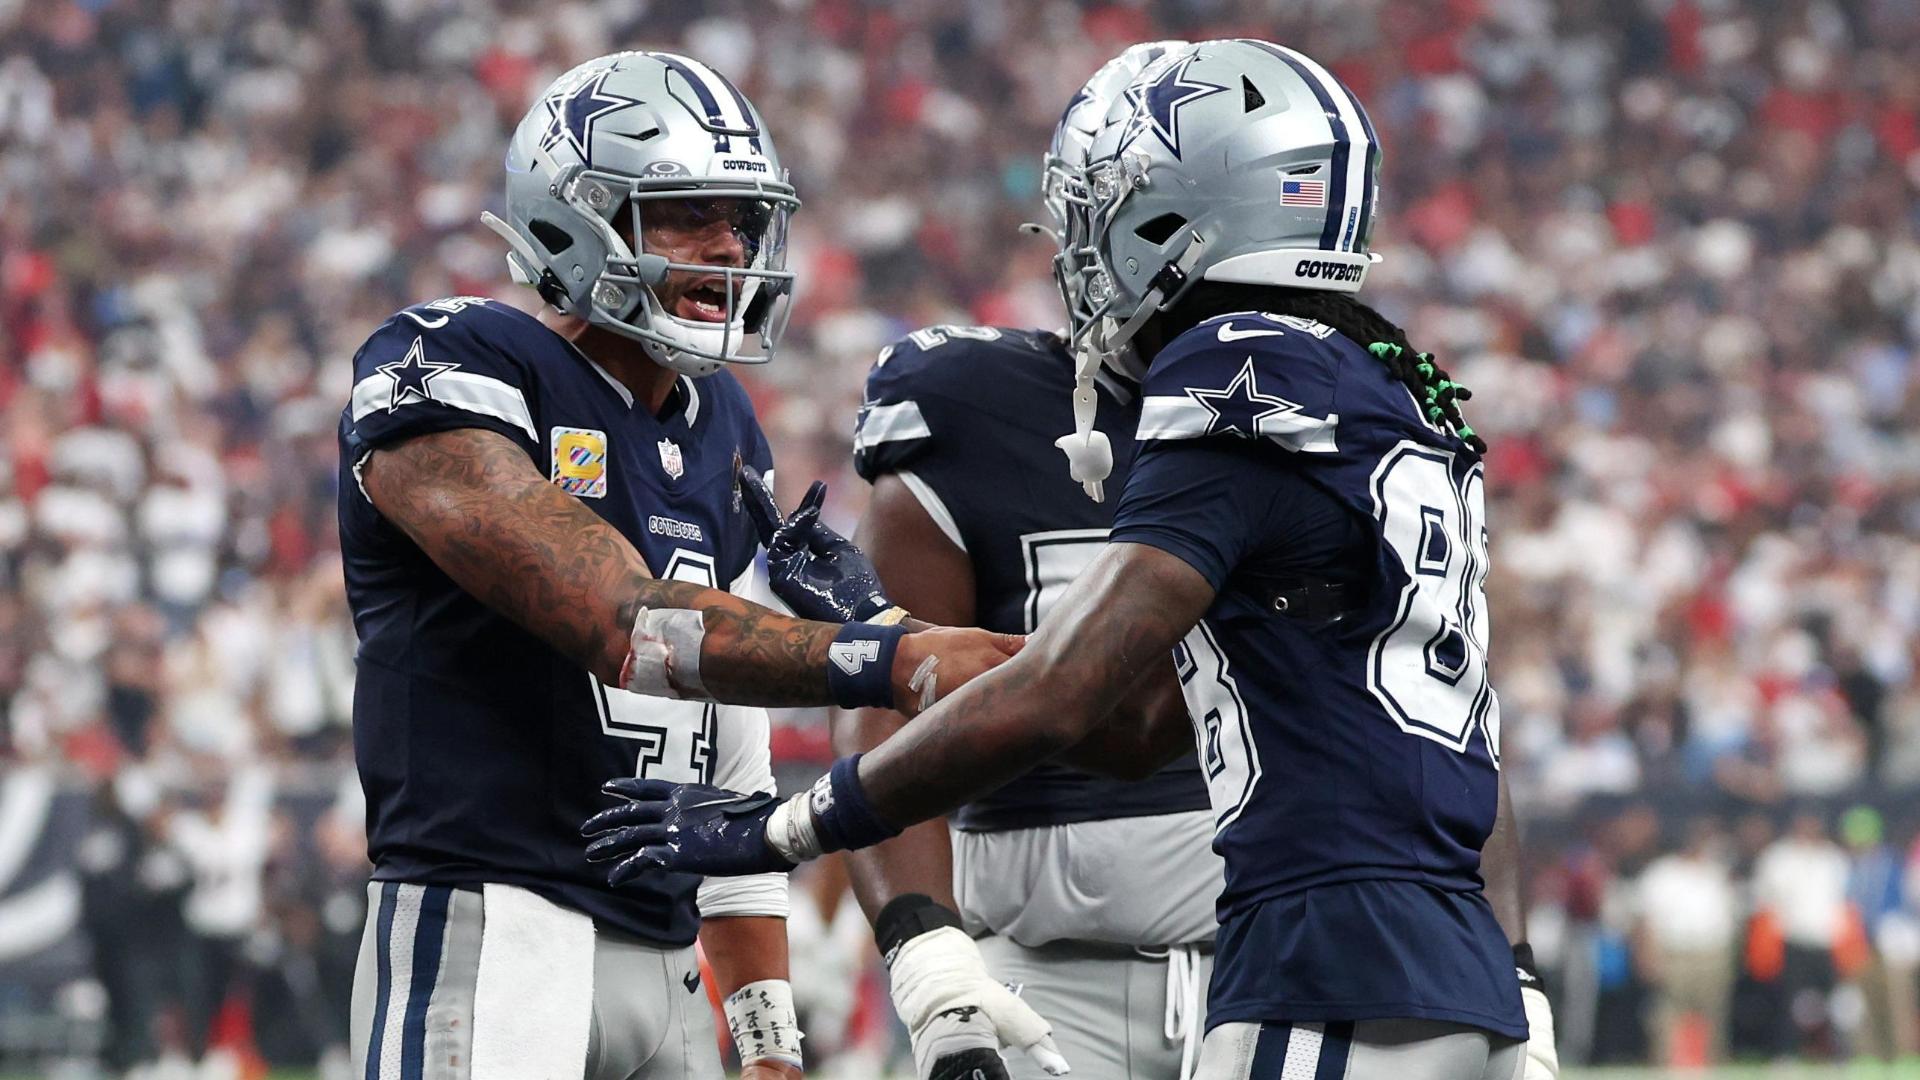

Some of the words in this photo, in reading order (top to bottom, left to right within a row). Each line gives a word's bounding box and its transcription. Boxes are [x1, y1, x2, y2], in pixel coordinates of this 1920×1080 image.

[723, 160, 767, 173] COWBOYS
[558, 433, 604, 480] C
[649, 515, 703, 542] COWBOYS
[828, 639, 880, 676] 4
